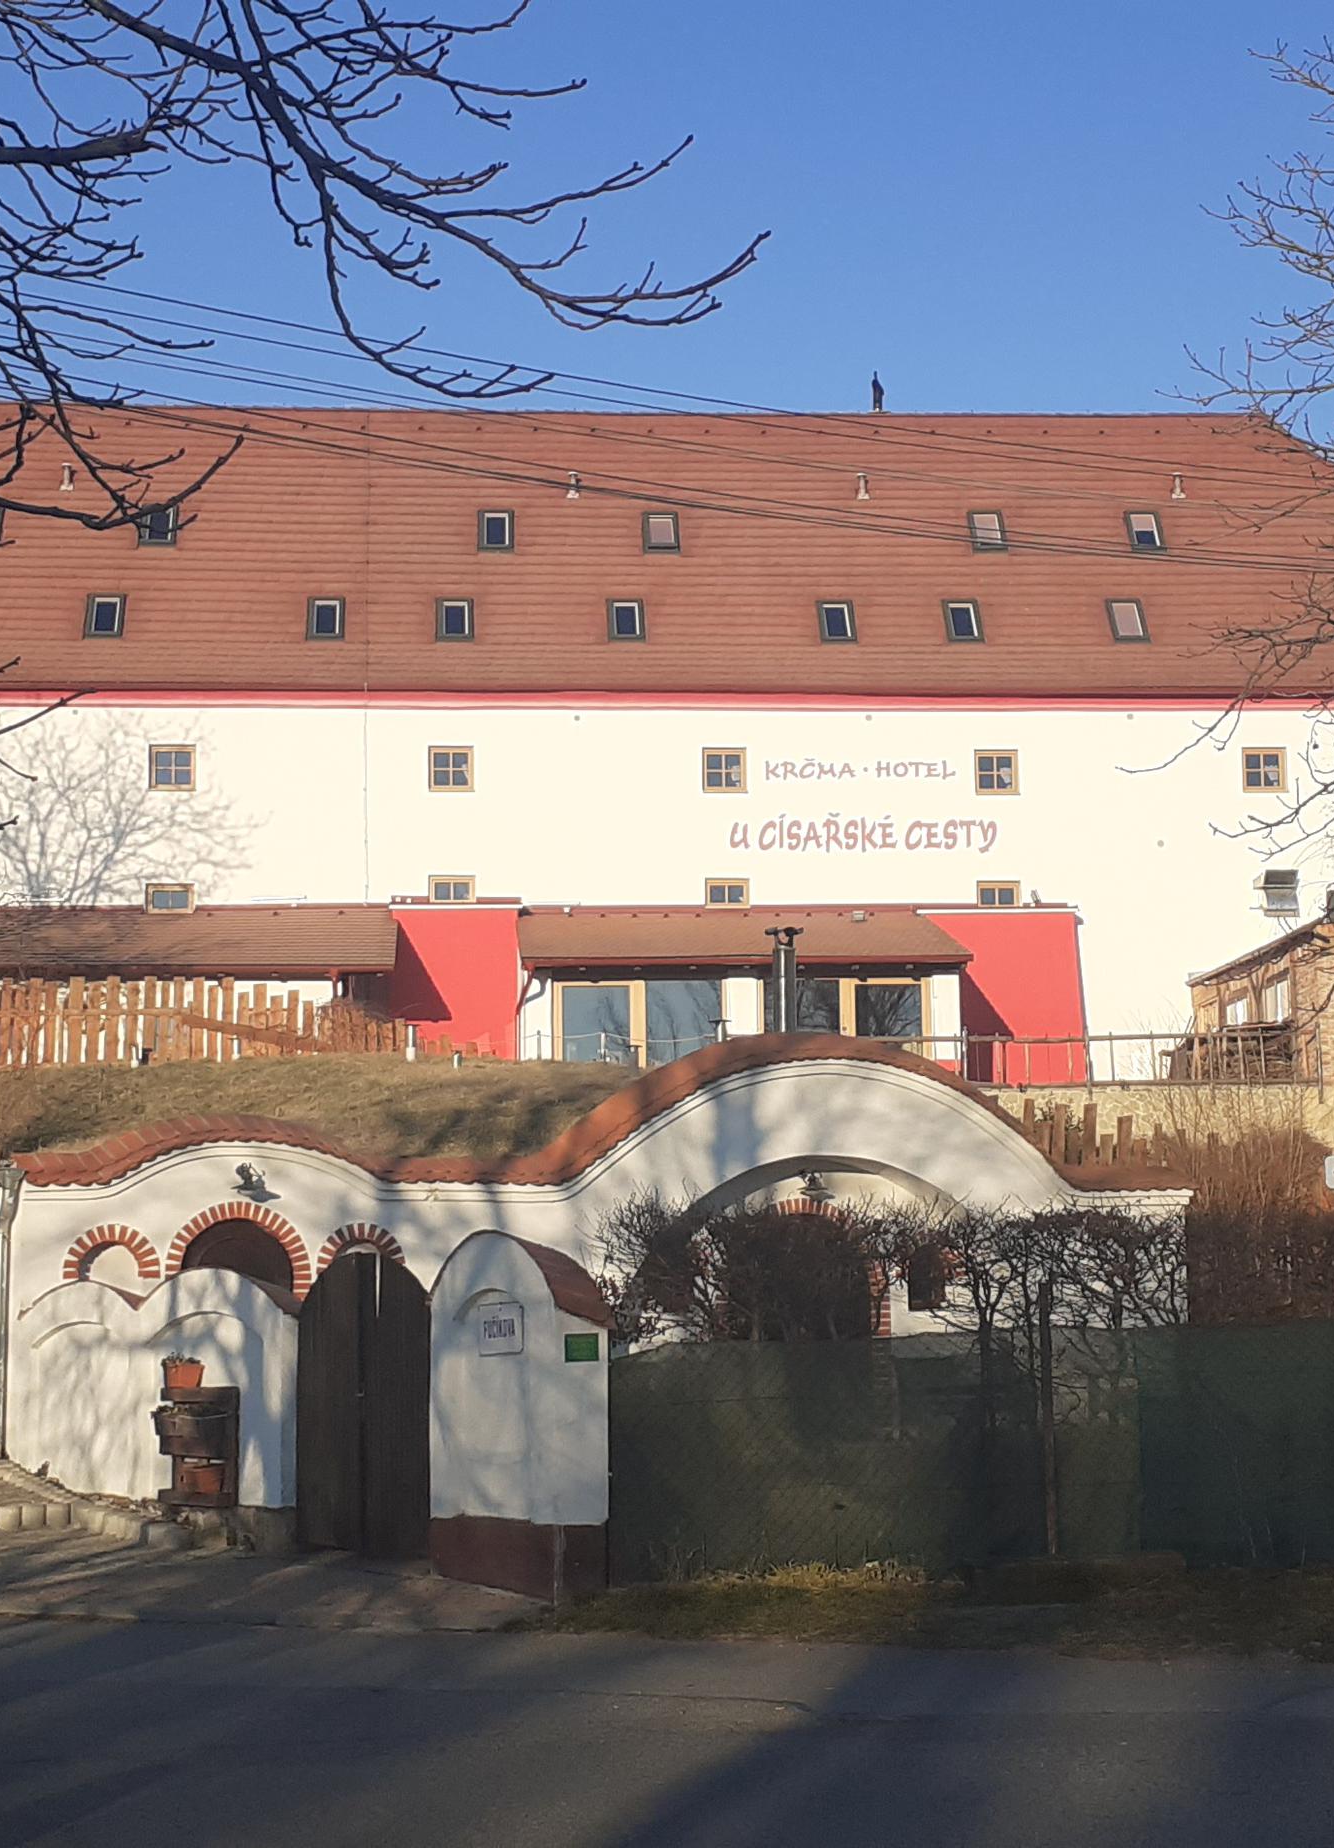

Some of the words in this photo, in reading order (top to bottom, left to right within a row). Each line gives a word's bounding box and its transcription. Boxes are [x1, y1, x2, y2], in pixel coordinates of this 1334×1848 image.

[765, 758, 857, 780] KRČMA
[875, 760, 957, 779] HOTEL
[730, 822, 751, 850] U
[758, 813, 898, 853] CÍSAŘSKÉ
[904, 818, 998, 853] CESTY
